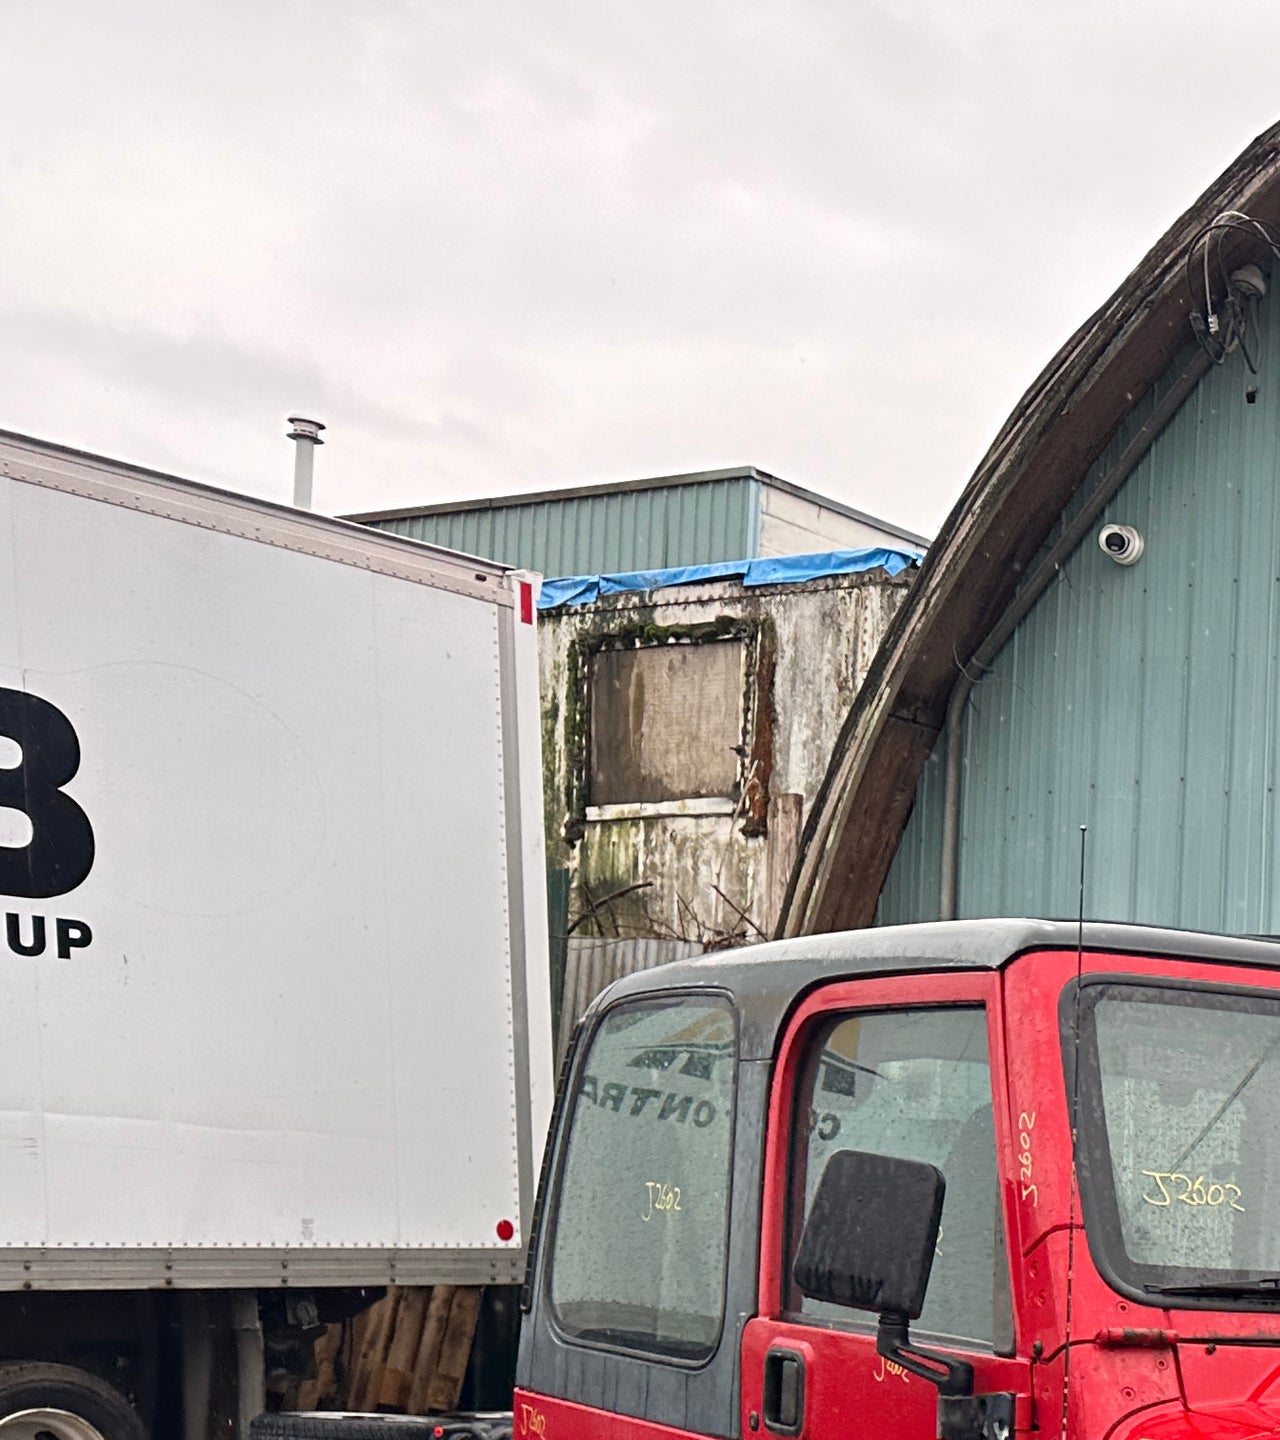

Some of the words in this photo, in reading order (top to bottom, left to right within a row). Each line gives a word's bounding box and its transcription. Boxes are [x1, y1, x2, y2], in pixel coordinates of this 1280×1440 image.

[7, 912, 93, 961] UP
[1019, 1111, 1037, 1208] J2602
[641, 1181, 682, 1222] J2602
[1142, 1169, 1246, 1213] J2602
